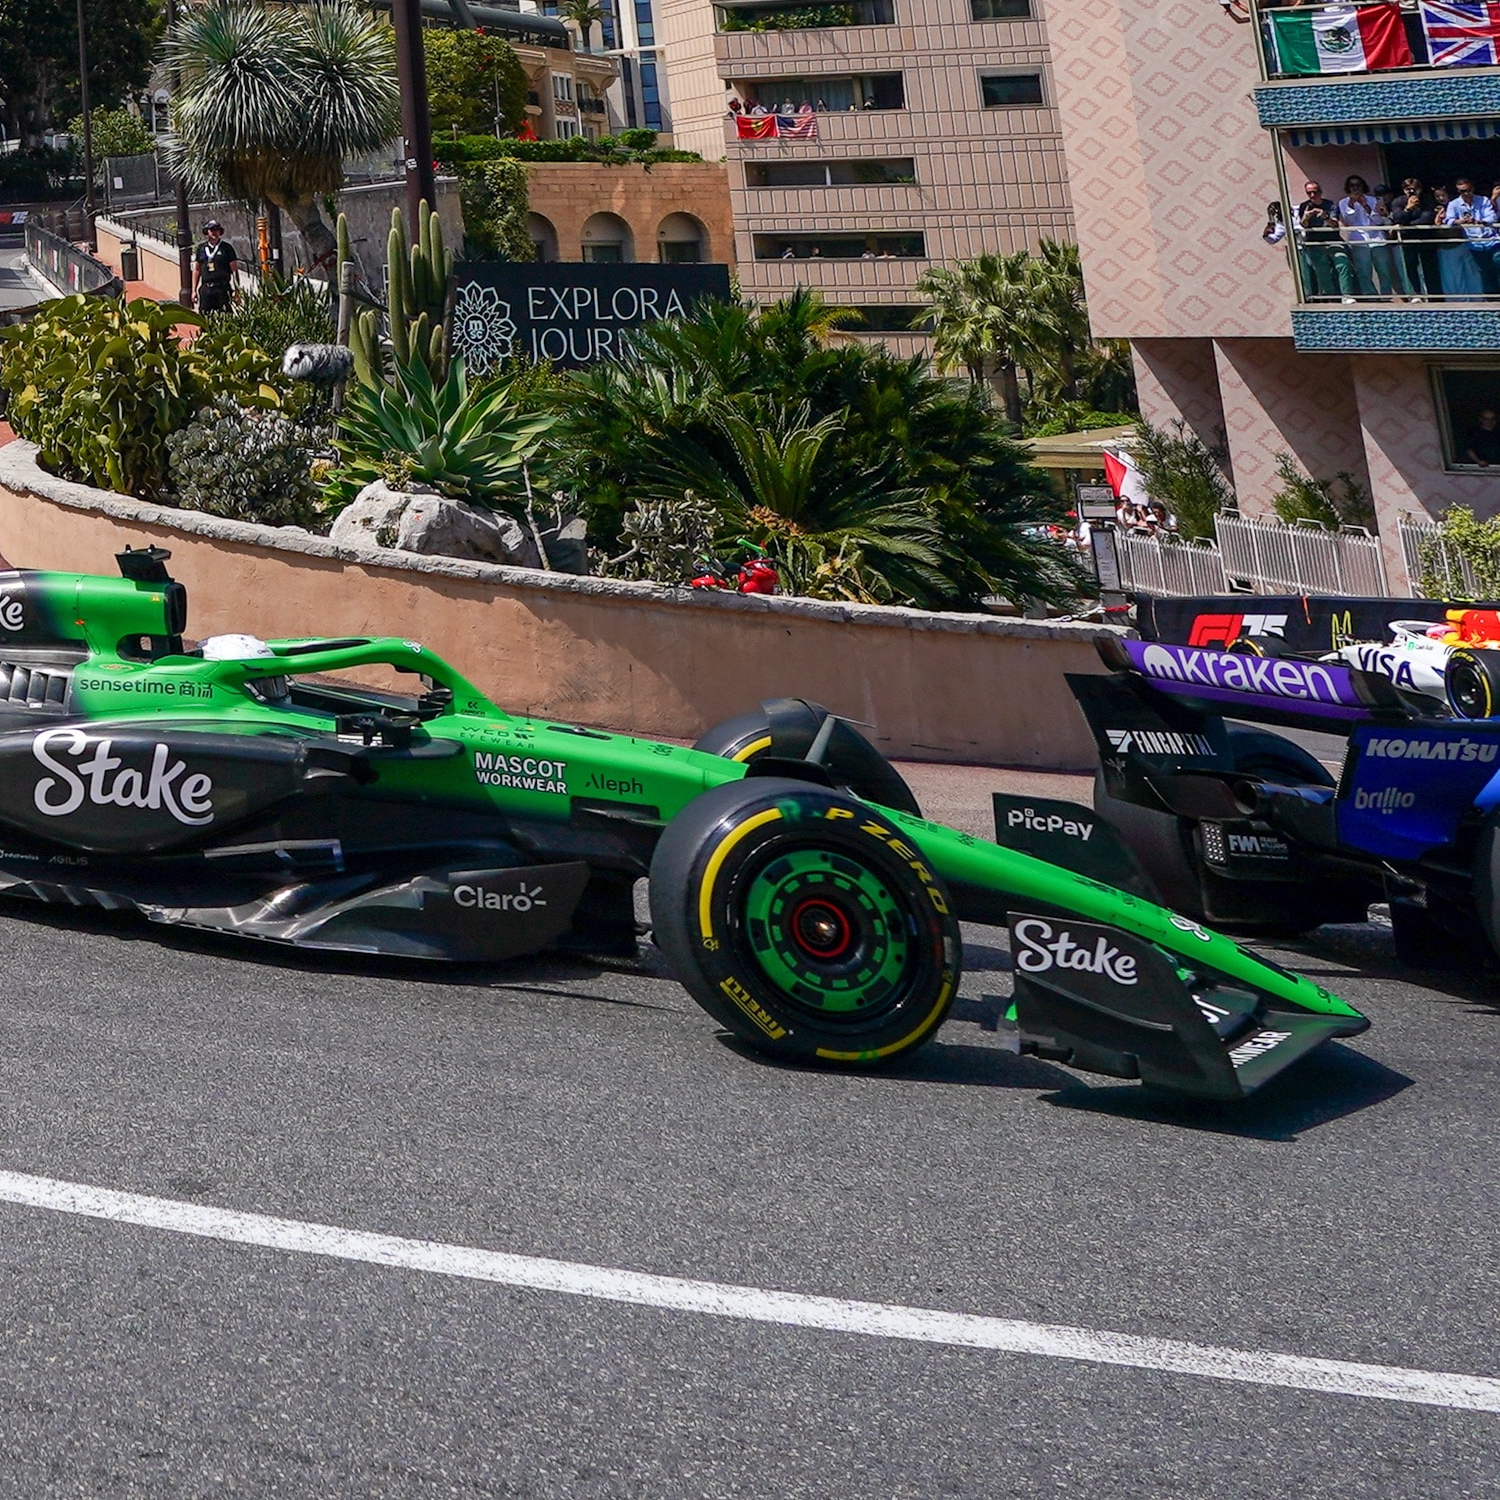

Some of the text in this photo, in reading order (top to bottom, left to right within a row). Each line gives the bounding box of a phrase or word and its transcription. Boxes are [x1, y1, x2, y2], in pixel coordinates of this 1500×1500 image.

[528, 286, 687, 321] EXPLORA
[1188, 614, 1289, 647] F1 75
[1176, 645, 1344, 706] kraken
[1358, 647, 1423, 692] VISA
[80, 677, 176, 696] sensetime
[459, 731, 536, 751] EYEWEAR
[1366, 737, 1499, 763] KOMATSU
[32, 727, 215, 826] Stake
[474, 751, 567, 780] MASCOT
[476, 770, 568, 796] WORKWEAR
[585, 772, 644, 795] Aleph
[1354, 786, 1416, 815] brillio
[1007, 807, 1093, 842] PicPay
[49, 855, 89, 867] AGILIS
[824, 807, 855, 820] P
[859, 819, 949, 914] ZERO
[453, 884, 532, 913] Claro
[1014, 918, 1139, 986] Stake
[719, 975, 788, 1041] PIRELLI
